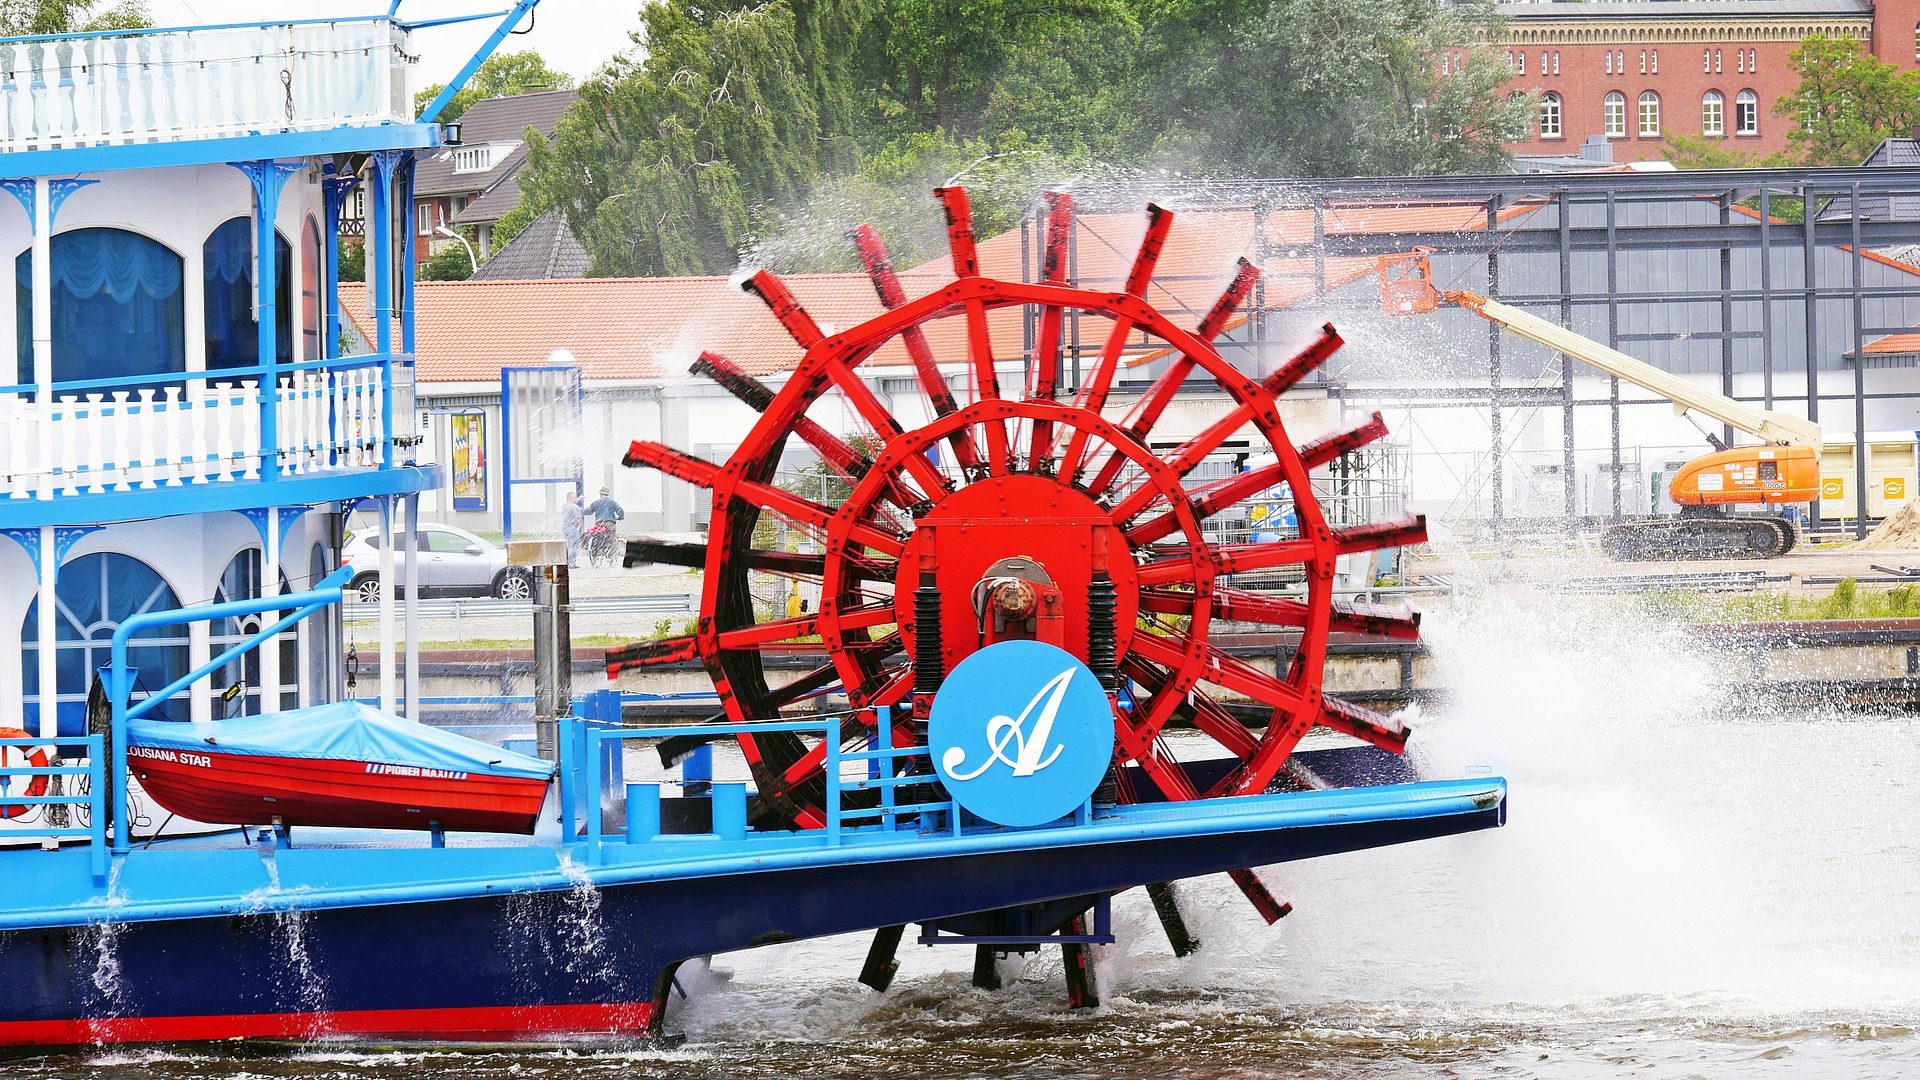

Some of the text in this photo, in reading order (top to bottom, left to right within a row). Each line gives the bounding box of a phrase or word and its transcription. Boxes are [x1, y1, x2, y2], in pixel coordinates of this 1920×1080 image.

[942, 666, 1078, 781] A
[126, 746, 212, 768] OUSIANA STAR
[384, 764, 449, 779] PIONER MAXI
